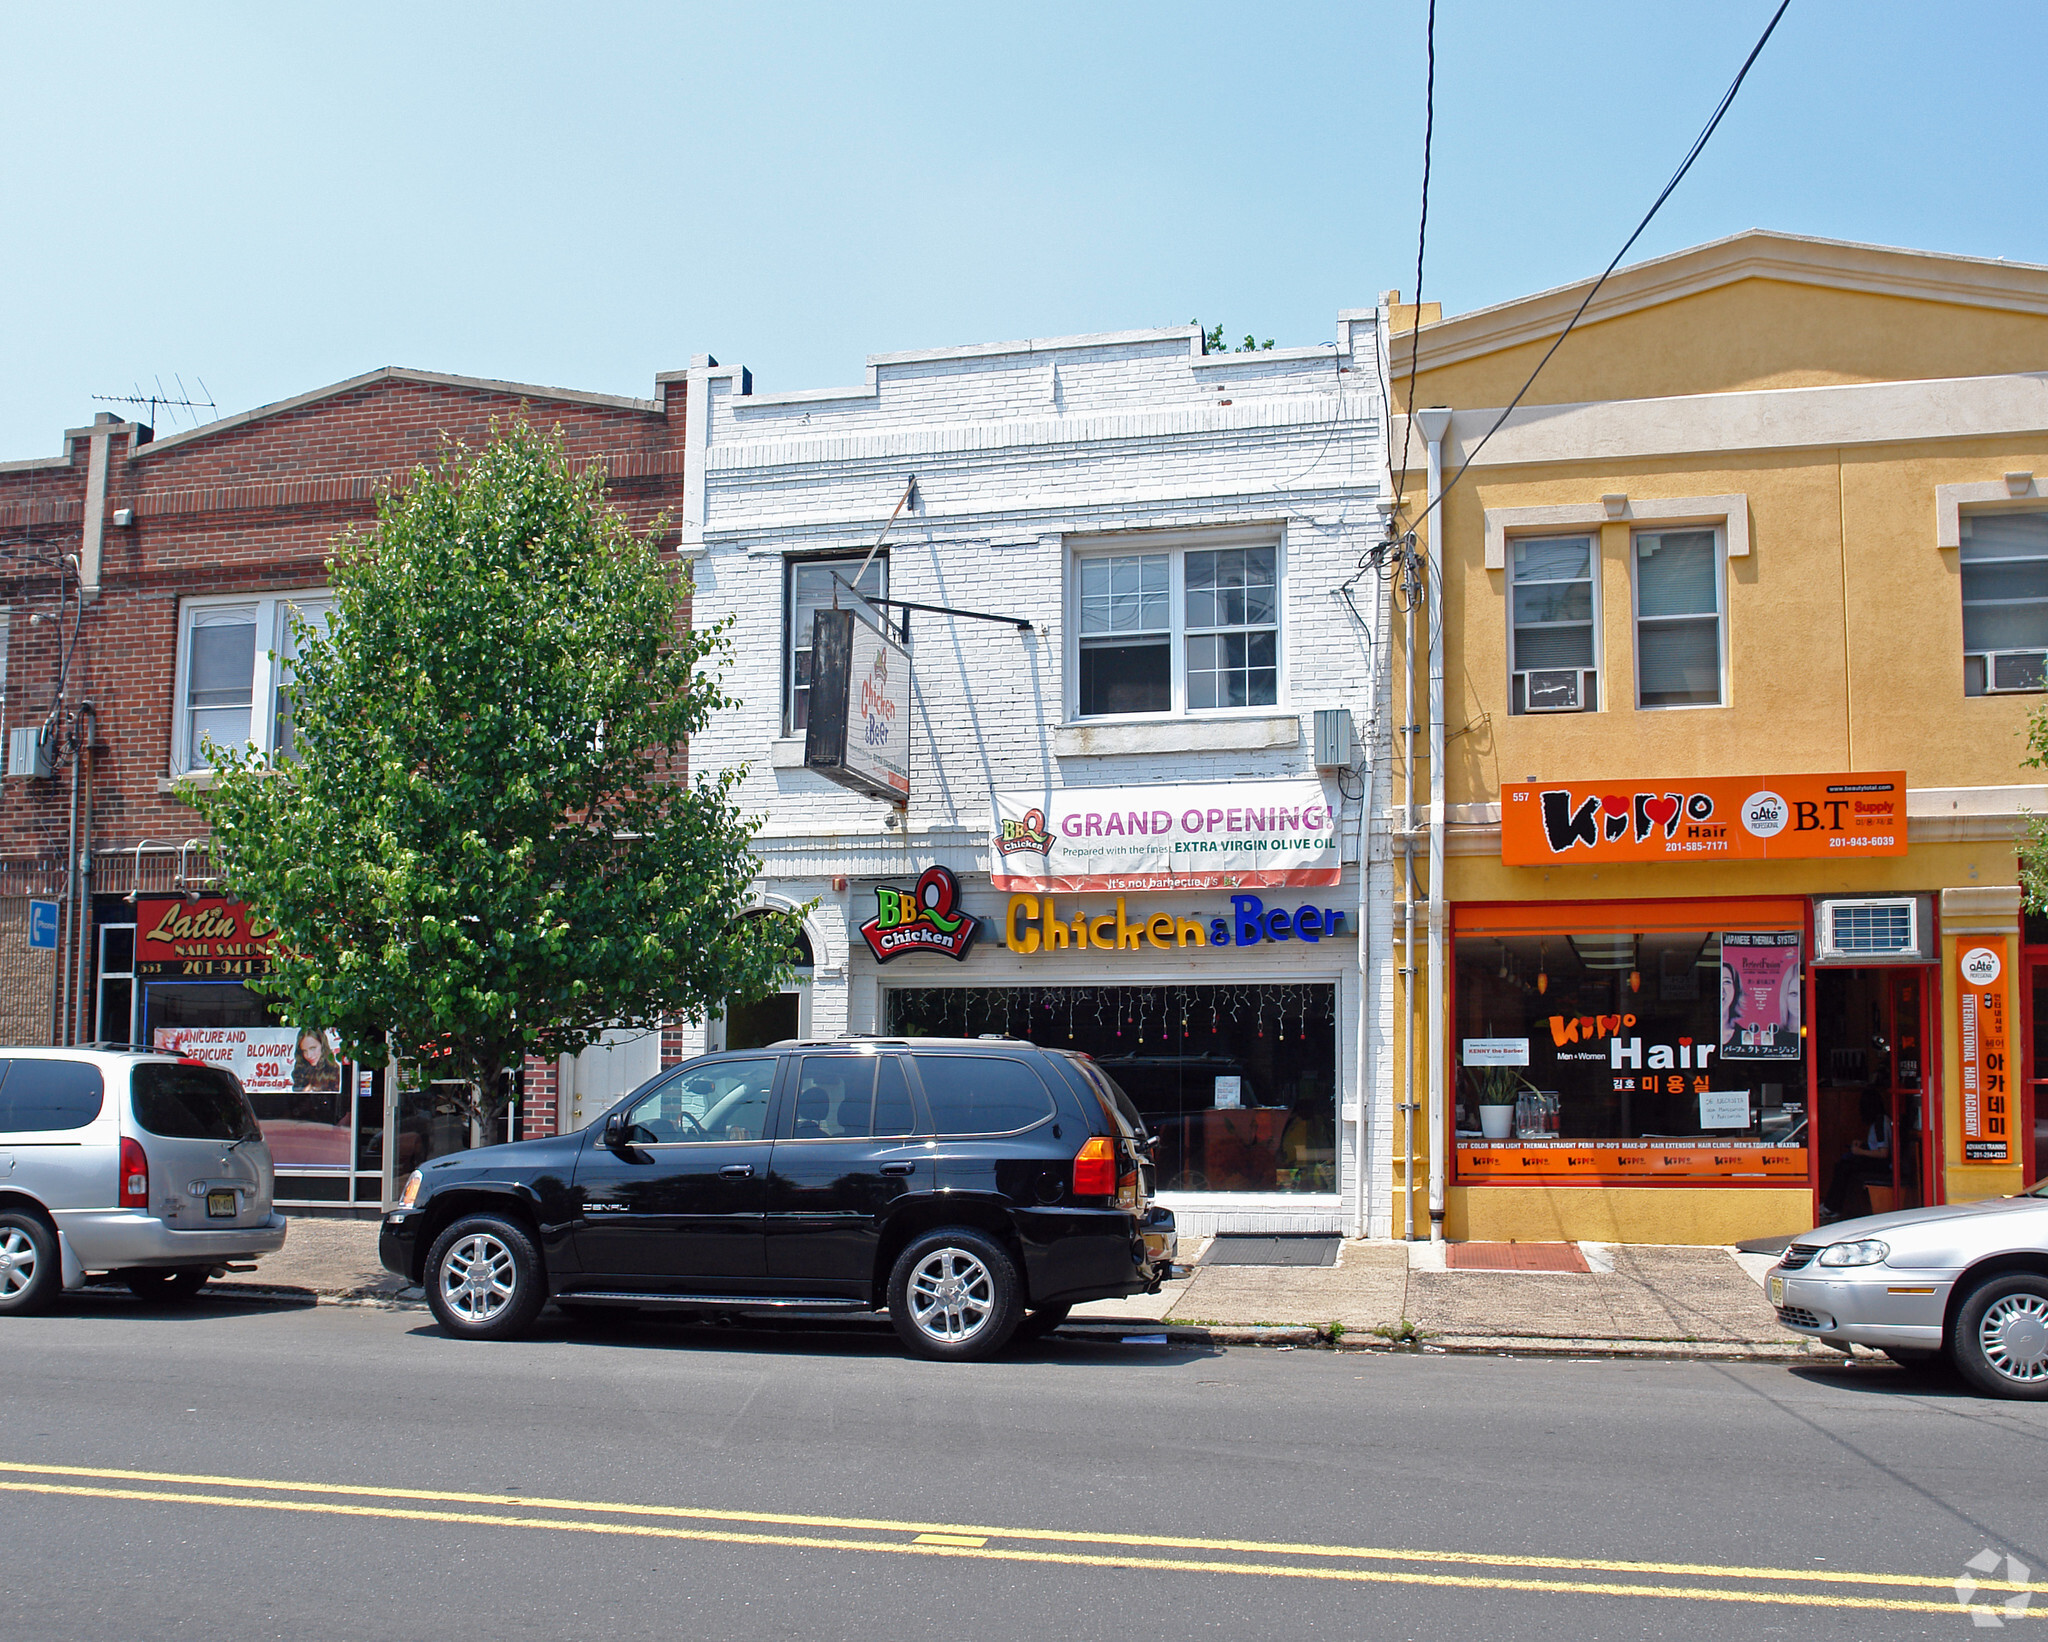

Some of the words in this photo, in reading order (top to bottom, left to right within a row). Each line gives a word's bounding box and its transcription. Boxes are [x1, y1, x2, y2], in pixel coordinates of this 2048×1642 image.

[861, 673, 896, 721] Chicken
[869, 713, 889, 746] Beer
[1512, 792, 1530, 802] 557
[1854, 801, 1895, 814] Supply
[1061, 811, 1173, 838] GRAND
[1181, 805, 1333, 834] OPENING!
[1792, 801, 1849, 832] B.T
[1002, 808, 1048, 843] BBQ
[1687, 825, 1728, 838] Hair
[1003, 841, 1044, 852] Chicken
[1062, 847, 1104, 858] Prepared
[1105, 846, 1127, 855] with
[1129, 845, 1145, 855] the
[1146, 843, 1173, 854] finest
[1174, 841, 1218, 853] EXTRA
[1220, 839, 1268, 852] VIRGIN
[1271, 838, 1311, 850] OLIVE
[1313, 838, 1337, 849] OIL
[1665, 841, 1729, 852] 201-585-7171
[1829, 836, 1895, 848] 201-943-6039
[1109, 878, 1125, 889] It's
[1127, 879, 1147, 888] not
[1149, 878, 1200, 889] barbecue
[1203, 877, 1219, 887] it's
[876, 867, 963, 932] BBQ
[146, 903, 237, 943] Latin
[1006, 892, 1207, 954] Chicken
[1209, 917, 1231, 947] &
[1230, 894, 1346, 947] Beer
[880, 928, 954, 949] Chicken
[1724, 935, 1751, 944] JAPANESE
[1752, 935, 1776, 945] THERMAL
[1777, 935, 1799, 944] SYSTEM
[174, 944, 212, 957] NAIL
[215, 944, 267, 957] SALON
[140, 963, 162, 973] 553
[1962, 994, 1976, 1062] INTERNATIONAL
[225, 1031, 247, 1043] AND
[187, 1048, 233, 1061] PEDICURE
[247, 1045, 295, 1058] BLOWDRY
[1557, 1052, 1574, 1060] Men
[1578, 1052, 1606, 1060] Women
[1610, 1037, 1716, 1069] Hair
[255, 1063, 279, 1078] $20
[1964, 1066, 1976, 1089] HAIR
[1613, 1078, 1636, 1091] 김호
[1642, 1076, 1710, 1094] 미용실
[1986, 1053, 2006, 1135] 아카데미
[1964, 1093, 1978, 1137] ACADEMY
[582, 1203, 630, 1211] DENALI
